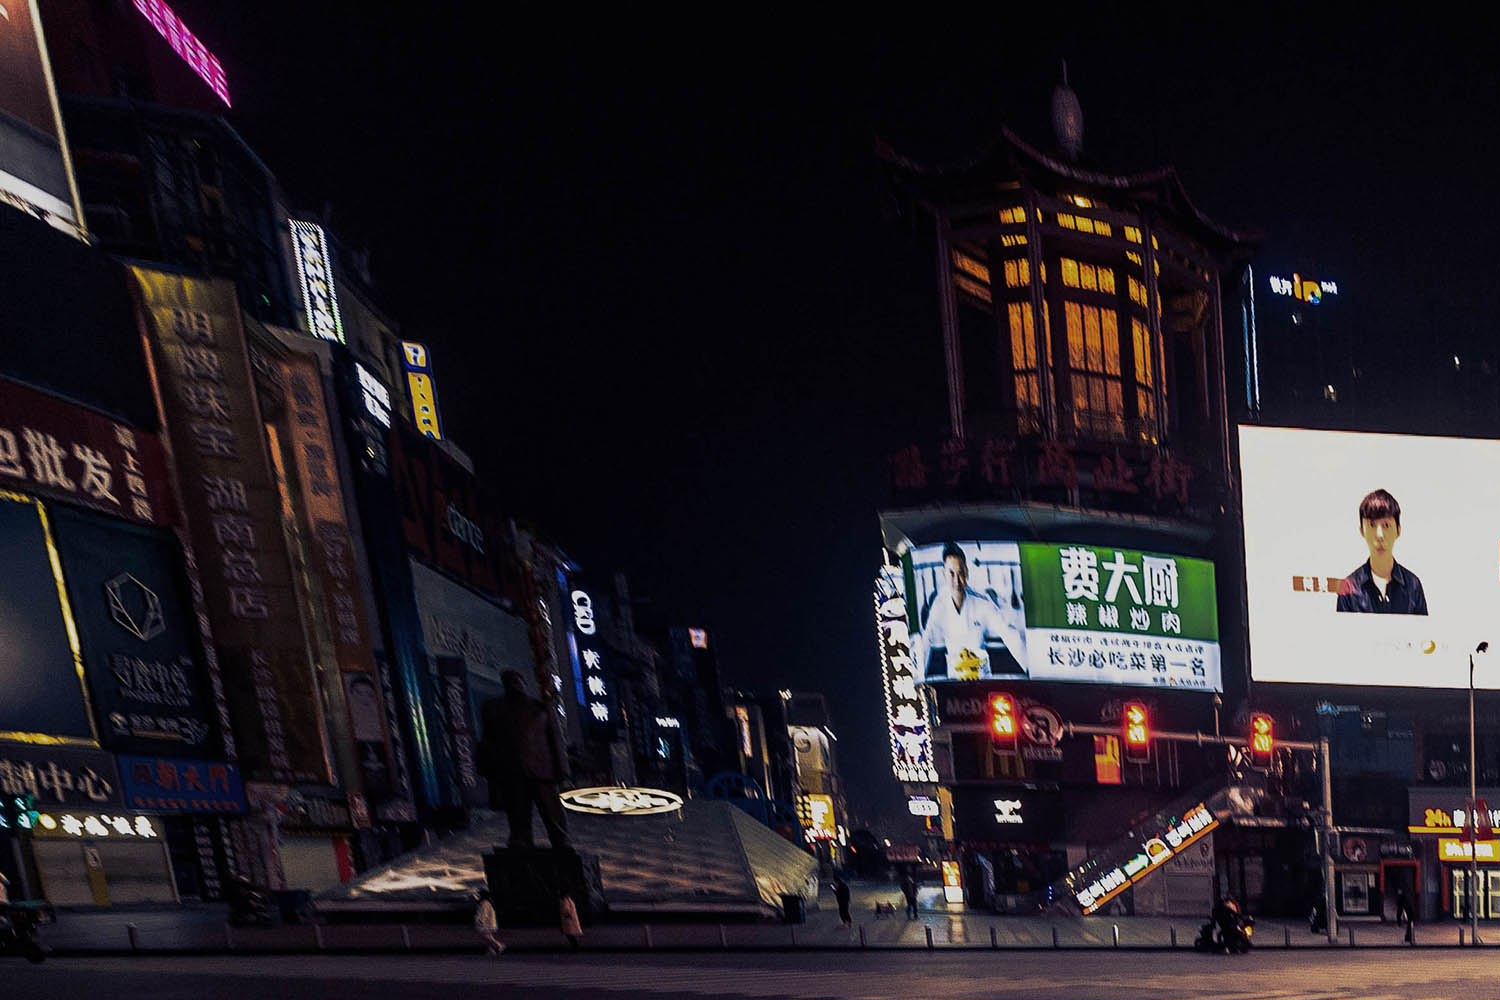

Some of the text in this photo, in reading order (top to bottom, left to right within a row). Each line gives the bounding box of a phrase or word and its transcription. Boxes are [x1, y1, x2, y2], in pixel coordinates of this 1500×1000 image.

[1059, 545, 1179, 609] 费大厨
[1065, 602, 1182, 634] 辣椒炒肉
[1046, 646, 1206, 677] 长沙必吃菜第一名
